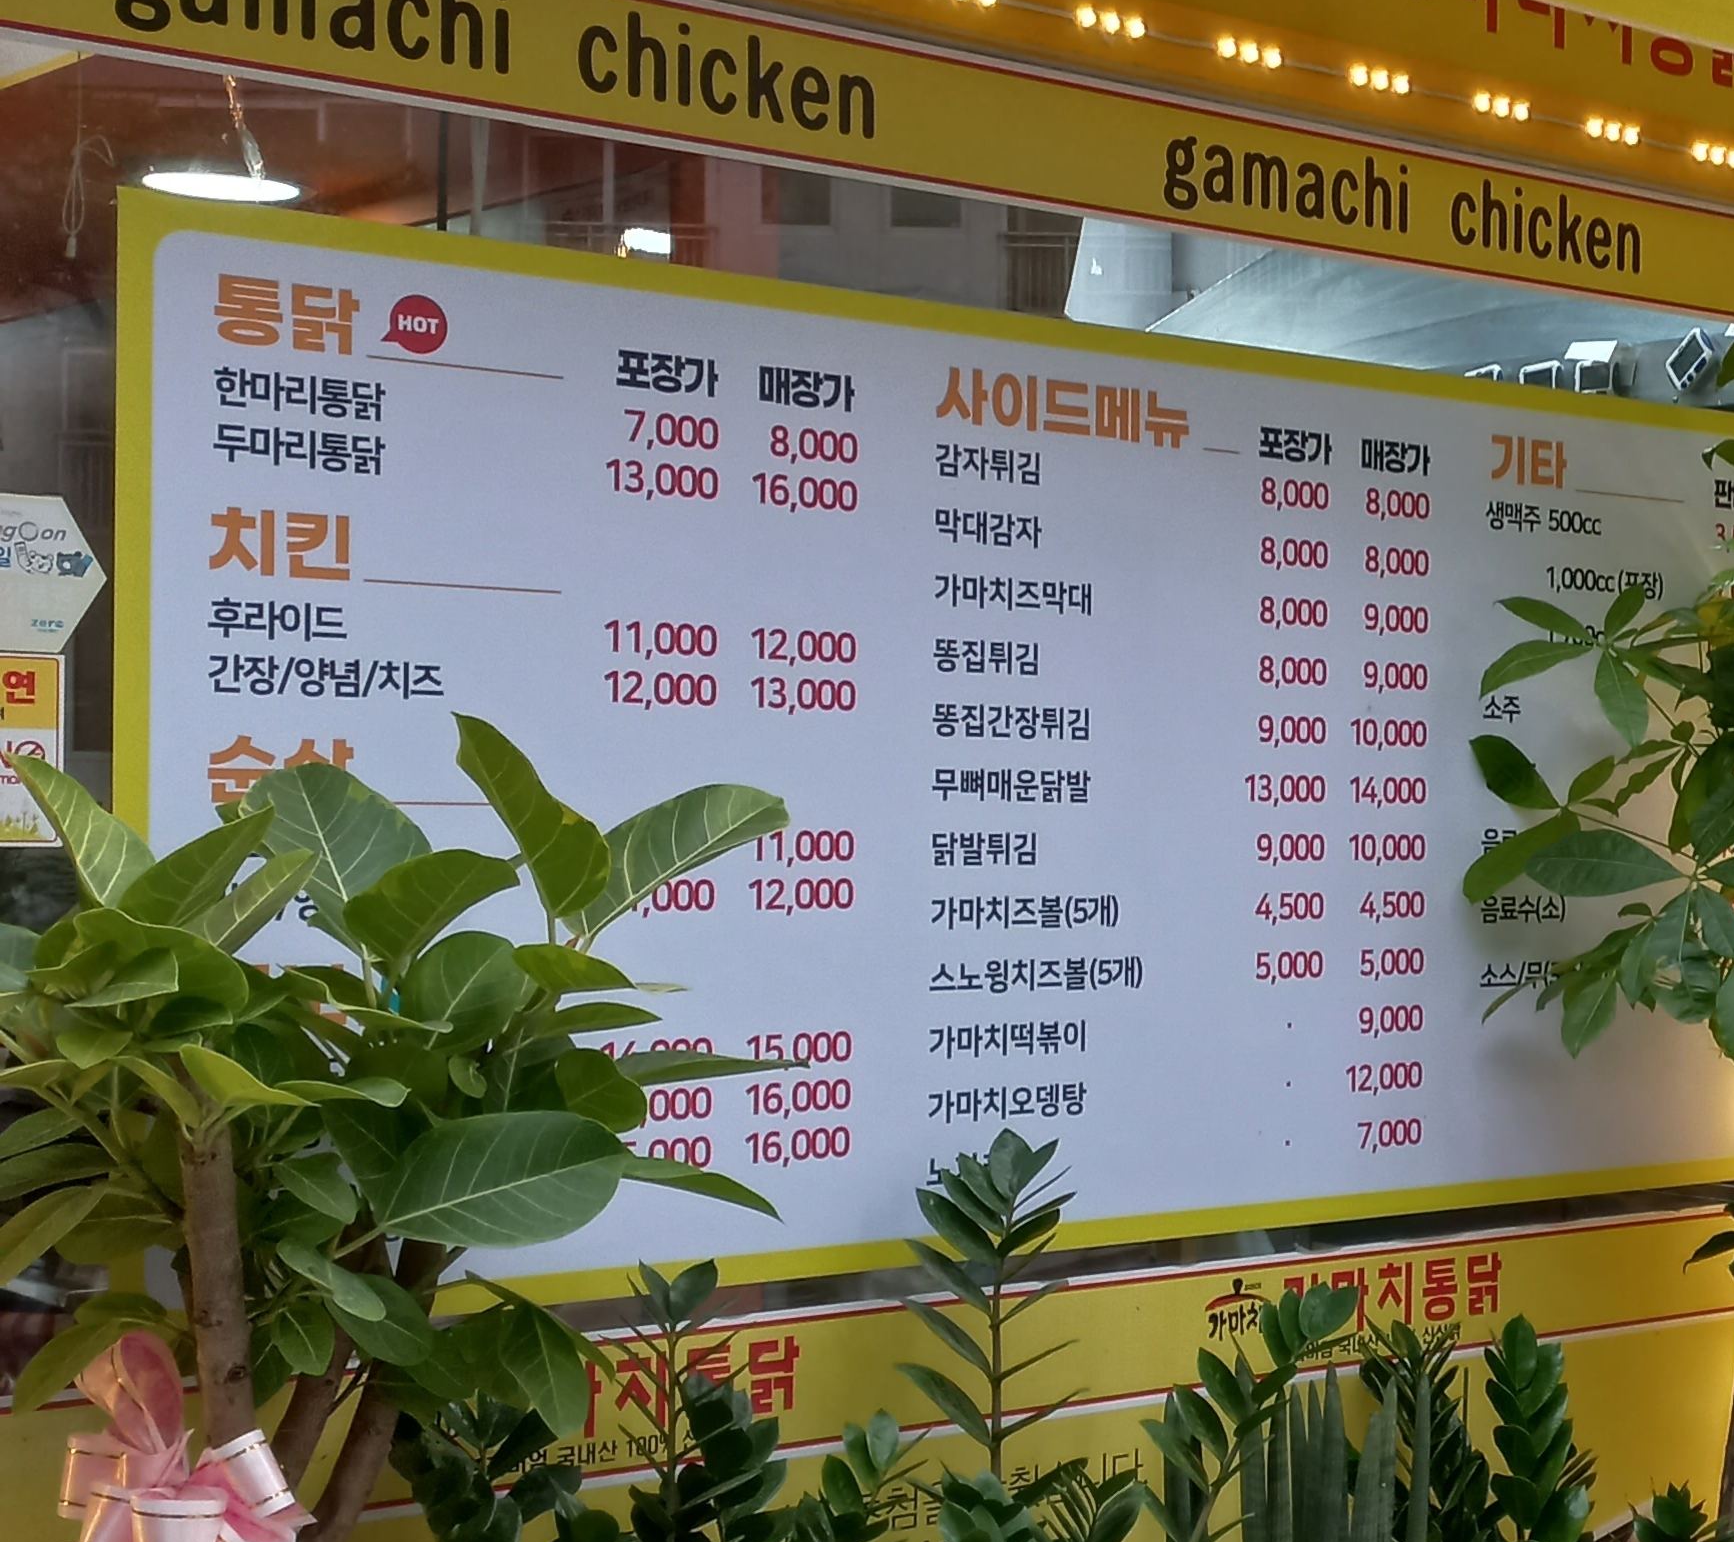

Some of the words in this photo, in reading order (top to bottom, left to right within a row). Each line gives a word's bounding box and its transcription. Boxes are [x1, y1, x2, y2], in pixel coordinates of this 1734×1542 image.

[577, 11, 877, 142] chicken
[1163, 133, 1408, 235] gamachi
[1450, 179, 1642, 276] chicken
[213, 272, 361, 356] 통닭
[397, 313, 440, 336] HOT
[616, 348, 719, 399] 포장가
[757, 364, 856, 413] 매장가
[213, 365, 387, 422] 한마리통닭
[623, 407, 720, 451] 7,000
[769, 423, 859, 464] 8,000
[935, 366, 1191, 450] 사이드메뉴
[213, 422, 387, 476] 두마리통닭
[604, 457, 720, 501] 13,000
[751, 472, 859, 514] 16,000
[1258, 425, 1333, 466] 포장가
[1361, 437, 1431, 477] 매장가
[1491, 433, 1568, 490] 기타
[935, 442, 1042, 487] 감자튀김
[1260, 476, 1330, 512] 8,000
[1365, 487, 1431, 521] 8,000
[208, 506, 351, 582] 치킨
[934, 508, 1043, 550] 막대감자
[1259, 535, 1329, 571] 8,000
[1364, 545, 1430, 579] 8,000
[1485, 500, 1542, 533] 생맥주
[1548, 508, 1603, 537] 500cc
[933, 573, 1093, 616] 가마치즈막대
[1259, 595, 1329, 631] 8,000
[1363, 603, 1429, 637] 9,000
[1546, 566, 1616, 594] 1,000cc
[207, 597, 348, 642] 후라이드
[603, 619, 719, 661] 11,000
[750, 627, 857, 668] 12,000
[207, 653, 445, 700] 간장/양념/치즈
[603, 669, 718, 711] 12,000
[750, 675, 857, 716] 13,000
[932, 638, 1040, 677] 똥집튀김
[1258, 655, 1328, 690] 8,000
[1363, 660, 1429, 694] 9,000
[932, 702, 1091, 742] 똥집간장튀김
[1257, 714, 1327, 748] 9,000
[1350, 717, 1428, 752] 10,000
[1483, 694, 1522, 724] 소주
[931, 768, 1092, 804] 무뼈매운닭발
[1244, 773, 1326, 808] 13,000
[1349, 775, 1427, 809] 14,000
[753, 829, 856, 869] 11,000
[931, 832, 1039, 867] 닭발튀김
[1255, 833, 1325, 867] 9,000
[1348, 833, 1426, 867] 10,000
[748, 877, 855, 917] 12,000
[930, 894, 1120, 930] 가마치즈볼(5개)
[1254, 891, 1324, 926] 4,500
[1359, 890, 1426, 925] 4,500
[1480, 894, 1567, 925] 음료수(소)
[928, 955, 1144, 994] 스노윙치즈볼(5개)
[1255, 949, 1324, 985] 5,000
[1359, 947, 1425, 981] 5,000
[746, 1029, 853, 1069] 15000
[928, 1019, 1088, 1060] 가마치떡볶이
[1358, 1003, 1424, 1039] 9,000
[745, 1078, 853, 1120] 16,000
[927, 1081, 1088, 1124] 가마치오뎅탕
[1345, 1061, 1424, 1097] 12,000
[744, 1125, 852, 1168] 16,000
[1357, 1117, 1422, 1154] 7,000
[556, 1439, 619, 1467] 국내산
